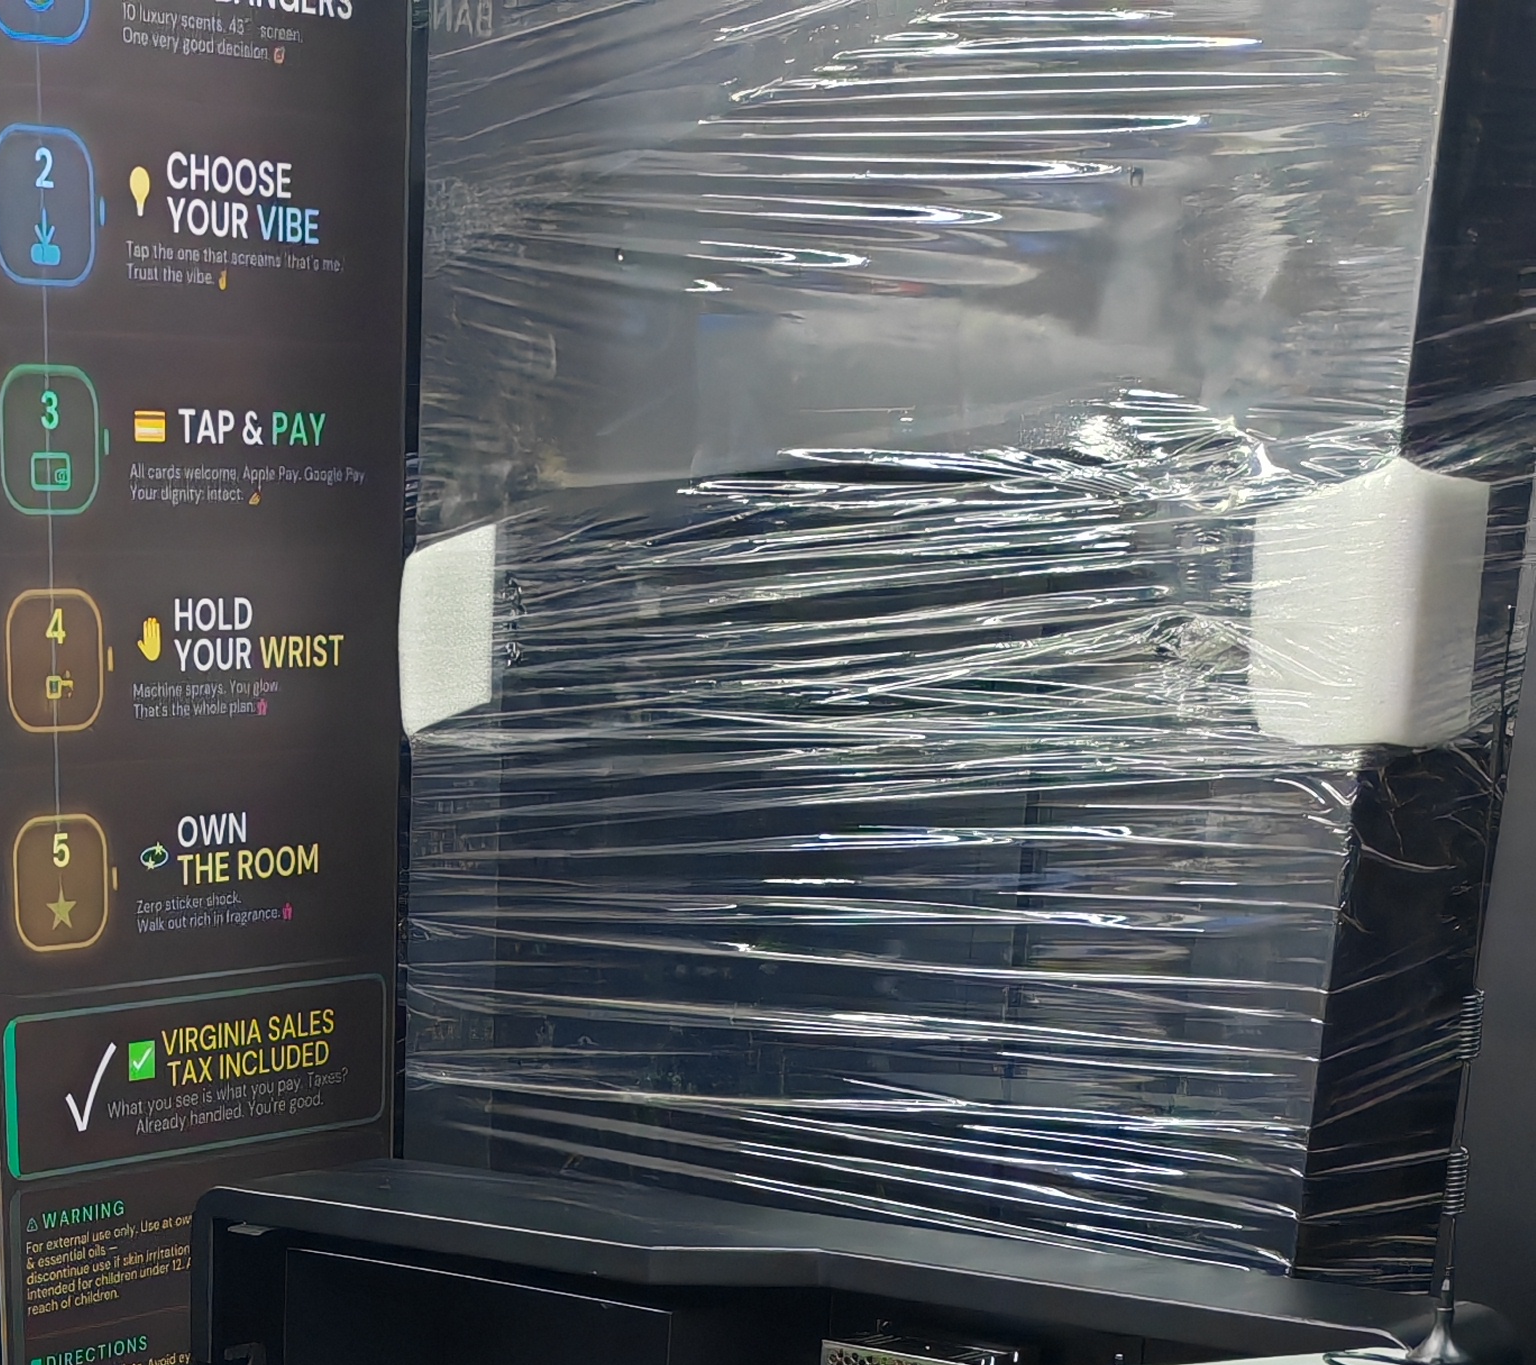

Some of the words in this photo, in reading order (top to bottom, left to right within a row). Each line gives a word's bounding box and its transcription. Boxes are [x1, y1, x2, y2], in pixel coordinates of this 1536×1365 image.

[122, 26, 149, 45] One
[152, 32, 179, 54] very
[183, 36, 214, 56] good
[34, 147, 55, 189] 2
[166, 150, 293, 199] CHOOSE
[165, 196, 249, 240] YOUR
[256, 203, 321, 245] VIBE
[125, 240, 150, 262] Tap
[152, 243, 173, 260] the
[177, 248, 200, 262] one
[203, 248, 228, 266] that
[125, 262, 159, 282] Trust
[163, 265, 183, 283] the
[40, 389, 60, 430] 3
[177, 407, 236, 445] TAP
[241, 410, 264, 446] &
[271, 410, 326, 447] PAY
[147, 463, 181, 481] cards
[242, 465, 276, 484] Apple
[129, 485, 158, 501] Your
[45, 608, 66, 644] 4
[173, 596, 254, 632] HOLD
[173, 637, 252, 672] YOUR
[259, 634, 344, 669] WRIST
[132, 681, 183, 699] Machine
[229, 679, 250, 695] You
[171, 701, 191, 718] the
[192, 699, 228, 717] whole
[177, 811, 248, 848] OWN
[53, 832, 70, 868] 5
[176, 851, 230, 886] THE
[237, 843, 320, 881] ROOM
[136, 899, 163, 915] Zero
[165, 895, 203, 913] sticker
[137, 918, 164, 934] Walk
[167, 915, 187, 930] out
[189, 912, 212, 929] rich
[213, 912, 224, 926] in
[161, 1017, 263, 1057] VIRGINIA
[267, 1008, 336, 1042] SALES
[166, 1055, 213, 1088] TAX
[218, 1039, 331, 1081] INCLUDED
[107, 1100, 143, 1119] What
[147, 1099, 173, 1118] you
[175, 1092, 200, 1108] see
[202, 1088, 213, 1104] is
[216, 1083, 247, 1101] what
[250, 1080, 275, 1097] you
[135, 1114, 187, 1136] Already
[41, 1199, 126, 1230] WARNING
[26, 1241, 43, 1255] For
[46, 1233, 90, 1251] external
[92, 1229, 112, 1243] use
[140, 1218, 160, 1233] Use
[162, 1216, 174, 1229] at
[26, 1257, 35, 1271] &
[37, 1249, 86, 1269] essential
[88, 1244, 107, 1258] oils
[26, 1263, 89, 1286] discontinue
[92, 1259, 112, 1272] use
[123, 1252, 144, 1267] skin
[26, 1282, 76, 1301] intended
[94, 1269, 138, 1287] children
[139, 1265, 170, 1279] under
[27, 1300, 59, 1317] reach
